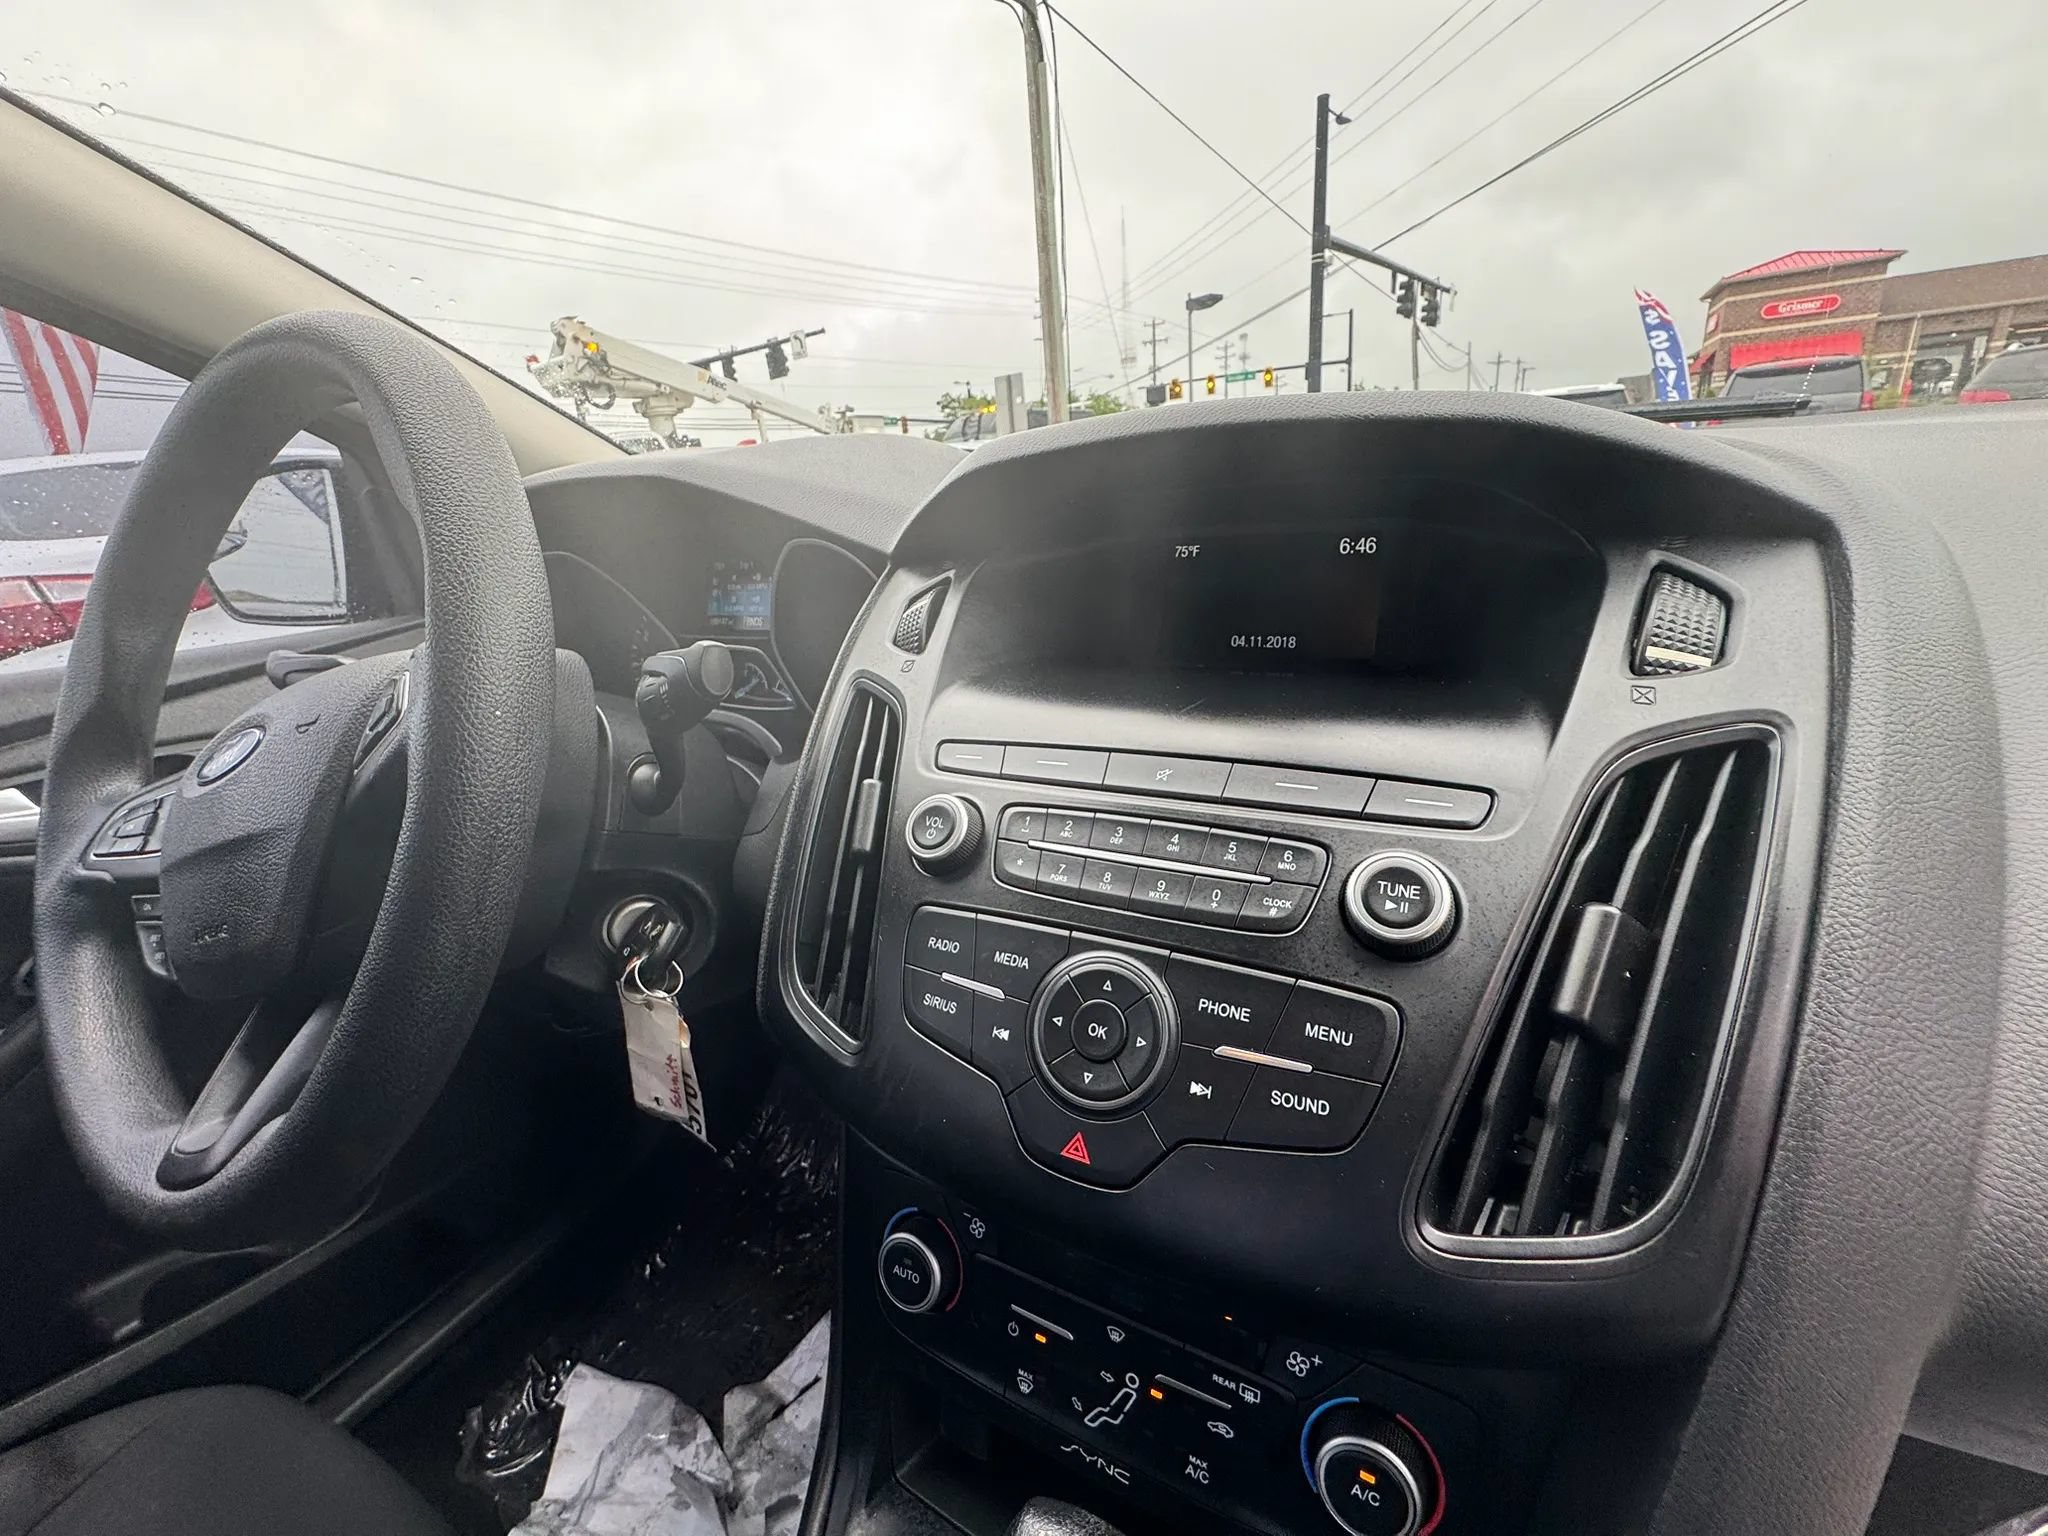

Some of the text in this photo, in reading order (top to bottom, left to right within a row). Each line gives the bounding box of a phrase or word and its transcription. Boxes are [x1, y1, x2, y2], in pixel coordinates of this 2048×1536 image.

[1778, 299, 1823, 314] Grismer
[1339, 537, 1377, 554] 6:46
[1230, 635, 1297, 649] 04.11.2018
[925, 816, 944, 829] VOL
[1024, 815, 1030, 826] 1
[1065, 820, 1073, 831] 2
[1115, 826, 1123, 837] 3
[1110, 837, 1124, 845] DEF
[1170, 833, 1179, 845] 4
[1166, 844, 1180, 853] GHI
[1228, 842, 1237, 853] 5
[1223, 853, 1237, 862] JKL
[1283, 851, 1293, 862] 6
[1059, 864, 1066, 874] 7
[1277, 862, 1296, 871] MNO
[1049, 873, 1068, 882] PQRS
[1103, 872, 1111, 883] 8
[1098, 882, 1113, 890] TUV
[1157, 880, 1166, 892] 9
[1377, 880, 1421, 900] TUNE
[1149, 890, 1170, 900] WXYZ
[1212, 889, 1221, 901] 0
[1263, 897, 1292, 909] CLOCK
[927, 936, 960, 954] RADIO
[993, 951, 1029, 970] MEDIA
[923, 993, 957, 1014] SIRIUS
[1198, 998, 1251, 1023] PHONE
[1087, 1022, 1109, 1040] OK
[1305, 1022, 1353, 1047] MENU
[1270, 1090, 1330, 1116] SOUND
[893, 1264, 920, 1284] AUTO
[1018, 1368, 1034, 1381] MAX
[1212, 1373, 1236, 1391] REAR
[1060, 1445, 1131, 1485] SYNC
[1188, 1454, 1208, 1470] MAX
[1184, 1463, 1210, 1485] A/C
[1350, 1483, 1380, 1507] A/C
